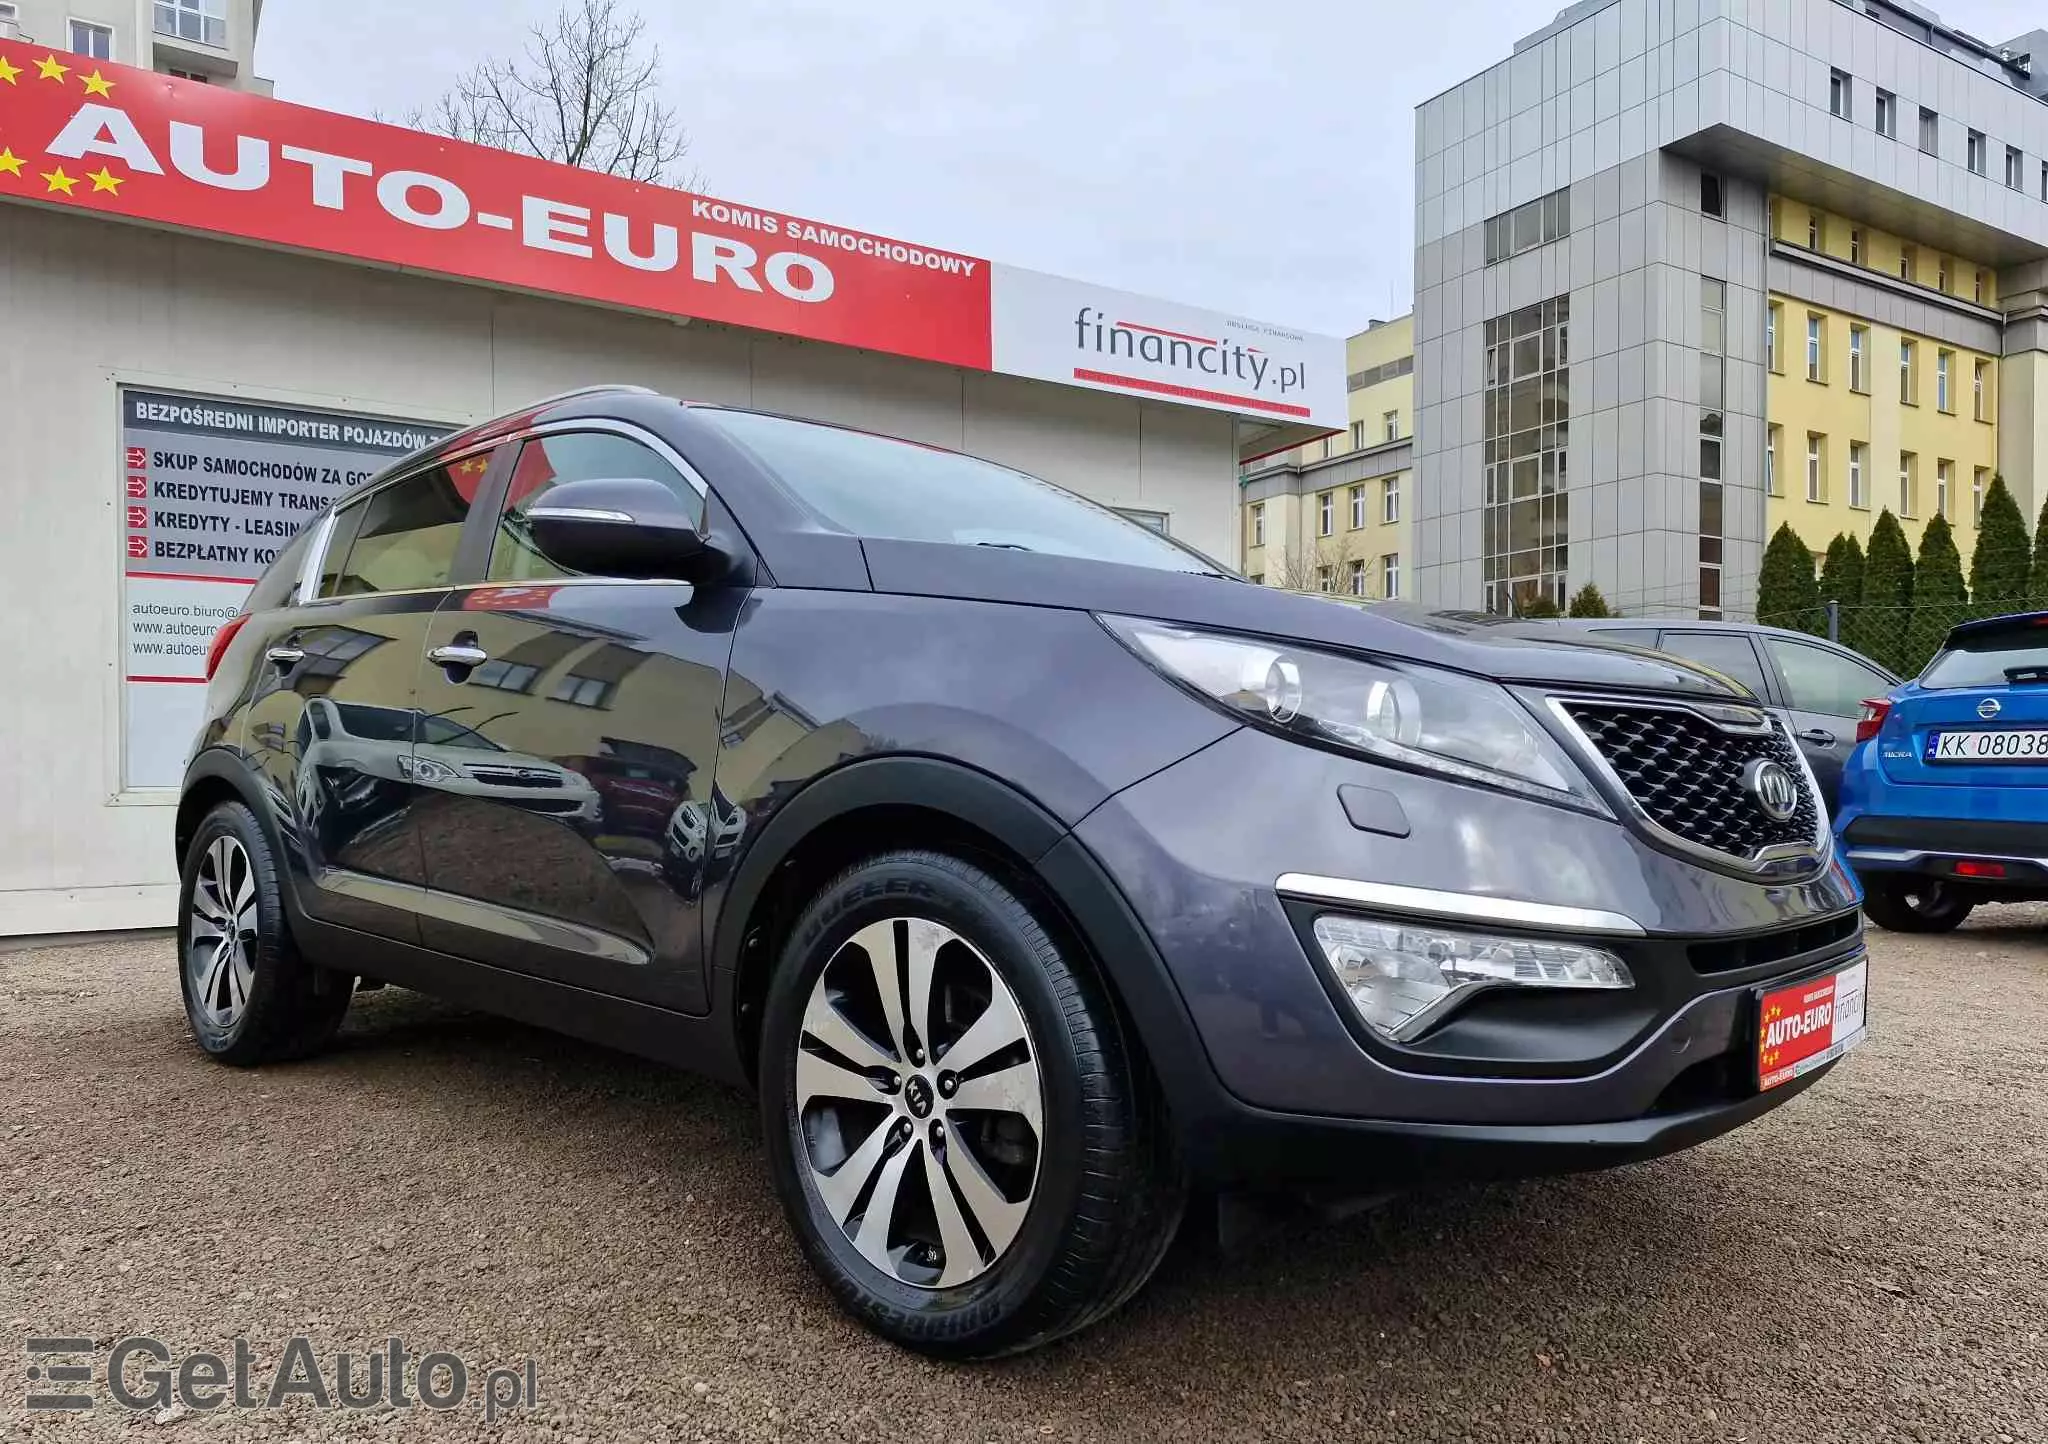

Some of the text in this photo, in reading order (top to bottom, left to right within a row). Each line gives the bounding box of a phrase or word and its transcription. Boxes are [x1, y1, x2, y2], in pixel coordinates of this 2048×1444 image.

[45, 102, 834, 302] AUTO-EURO
[692, 200, 975, 277] KOMIS SAMOCHODOWY
[1075, 307, 1304, 392] financity.pl
[136, 402, 426, 449] BEZPOŚREDNI IMPORTER POJAZDÓW
[153, 452, 198, 471] SKUP
[203, 456, 317, 482] SAMOCHODÓW
[321, 468, 341, 485] ZA
[154, 481, 274, 508] KREDYTUJEMY
[154, 511, 230, 532] KREDYTY
[155, 541, 249, 563] BEZPŁATNY
[1940, 733, 2048, 756] KK 08038
[1766, 1001, 1832, 1049] AUTO-EURO
